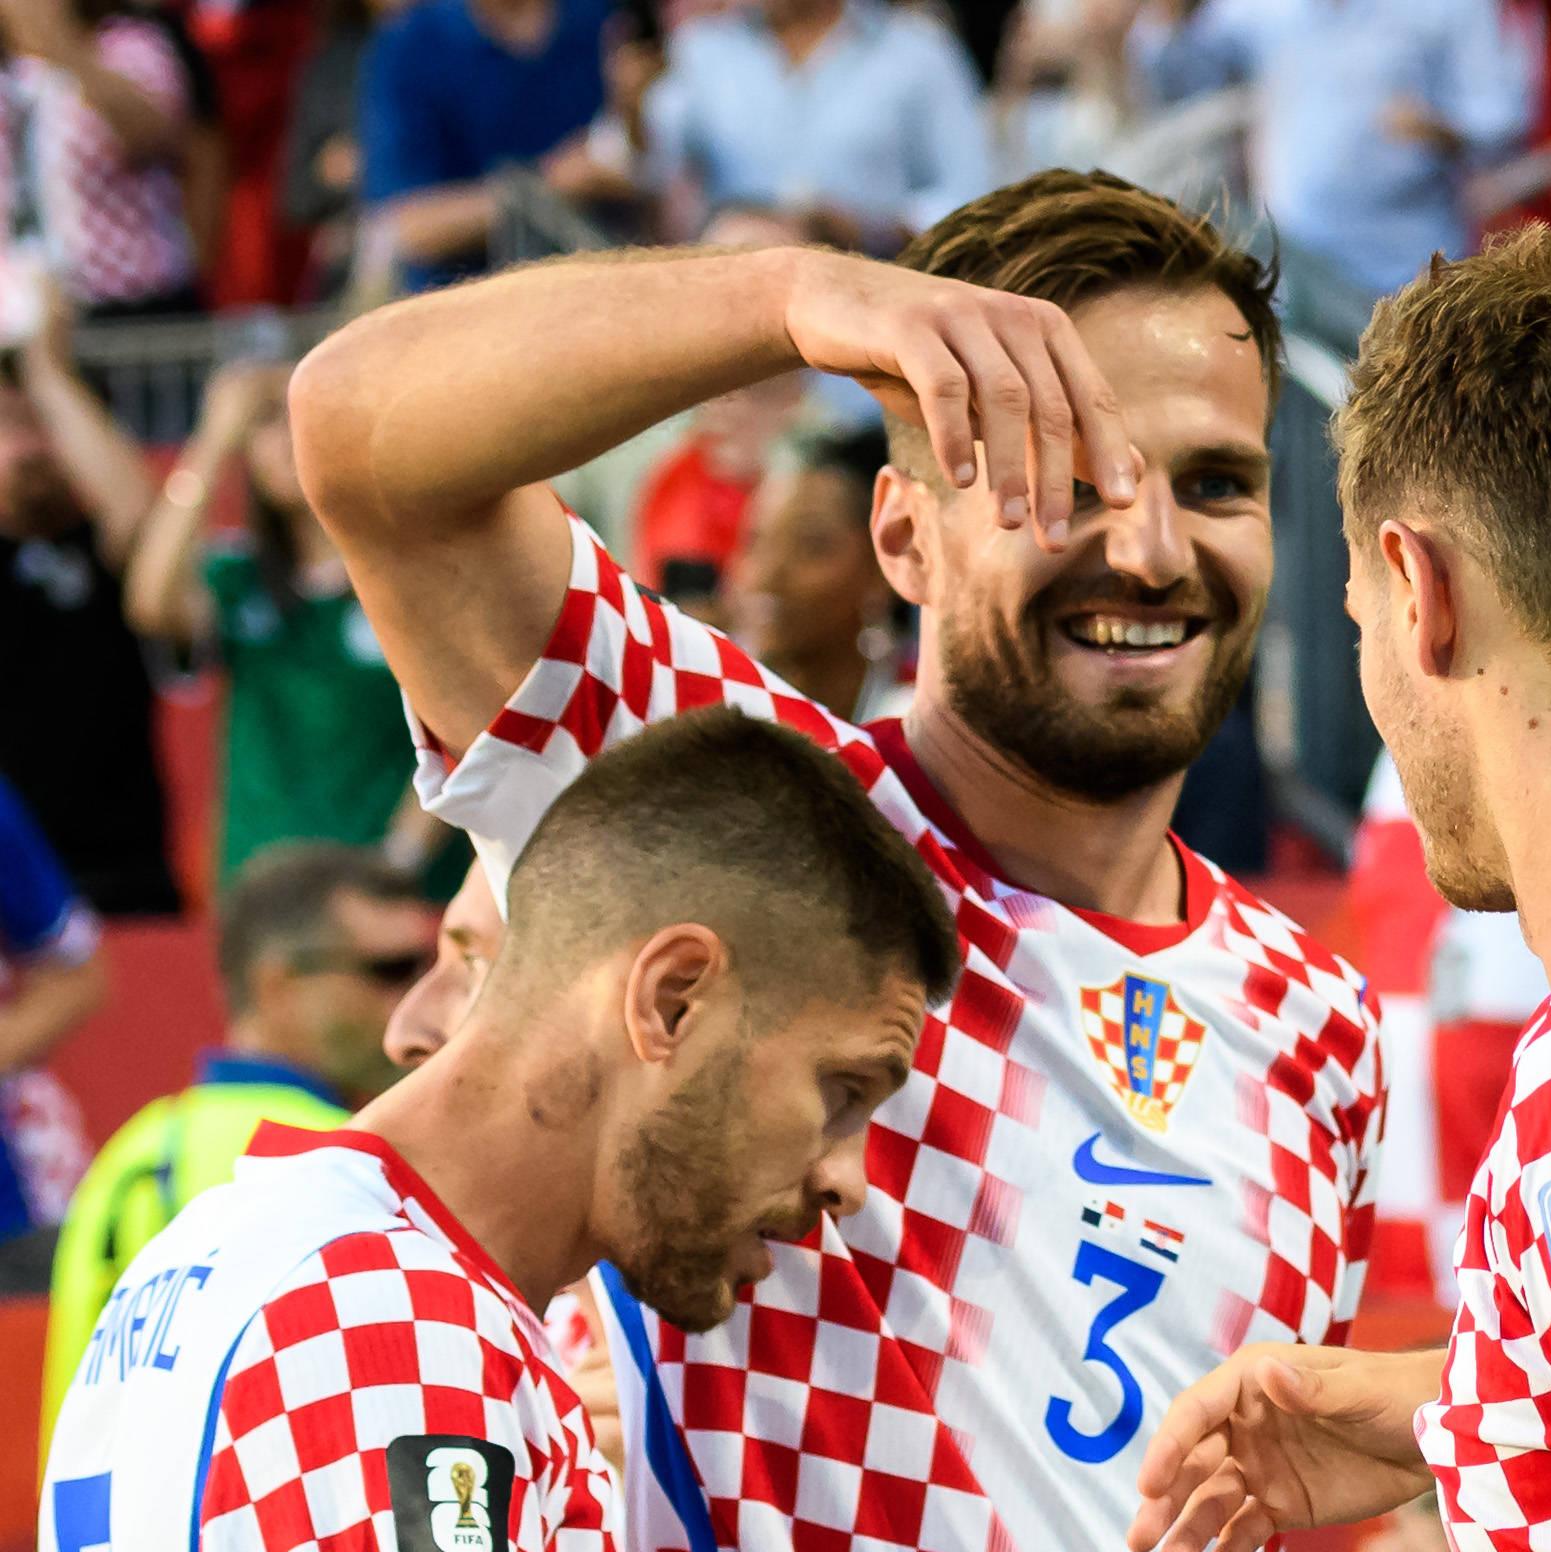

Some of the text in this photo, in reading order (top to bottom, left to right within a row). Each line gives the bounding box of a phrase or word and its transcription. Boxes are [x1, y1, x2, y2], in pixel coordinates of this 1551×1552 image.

[1131, 991, 1155, 1081] HNS
[1045, 1240, 1167, 1464] 3
[454, 1535, 484, 1545] FIFA
